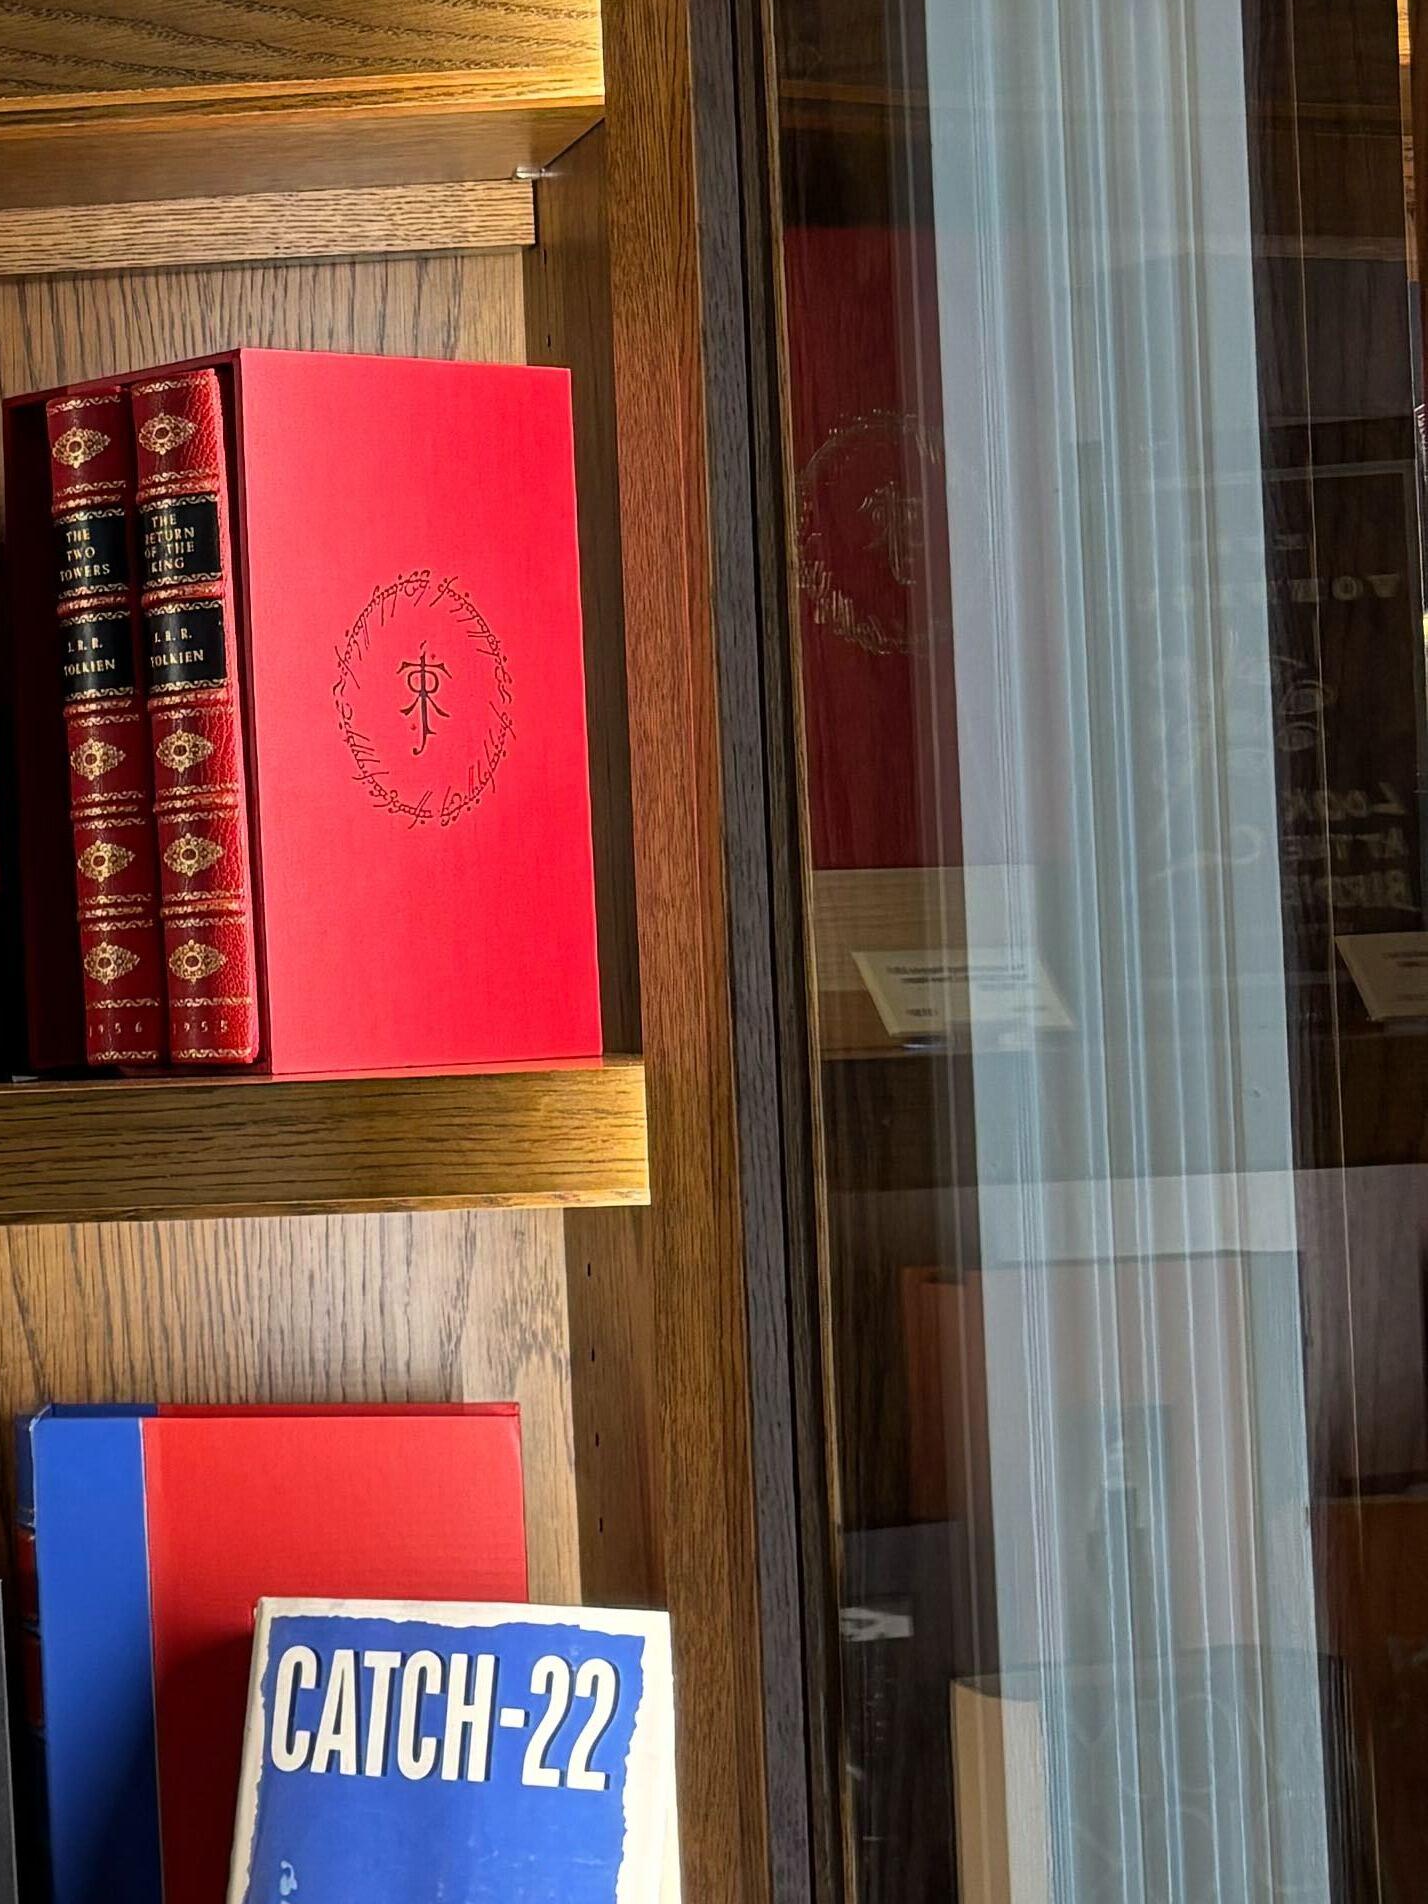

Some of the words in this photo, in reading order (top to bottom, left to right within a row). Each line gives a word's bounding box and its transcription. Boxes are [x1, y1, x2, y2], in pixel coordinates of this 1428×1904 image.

[152, 515, 176, 529] THE
[66, 528, 90, 542] THE
[67, 547, 95, 561] TWO
[60, 564, 110, 582] TOWERS
[151, 559, 184, 573] KING
[151, 650, 204, 667] TOLKIEN
[64, 659, 115, 676] TOLKIEN
[271, 1644, 620, 1790] CATCH-22
